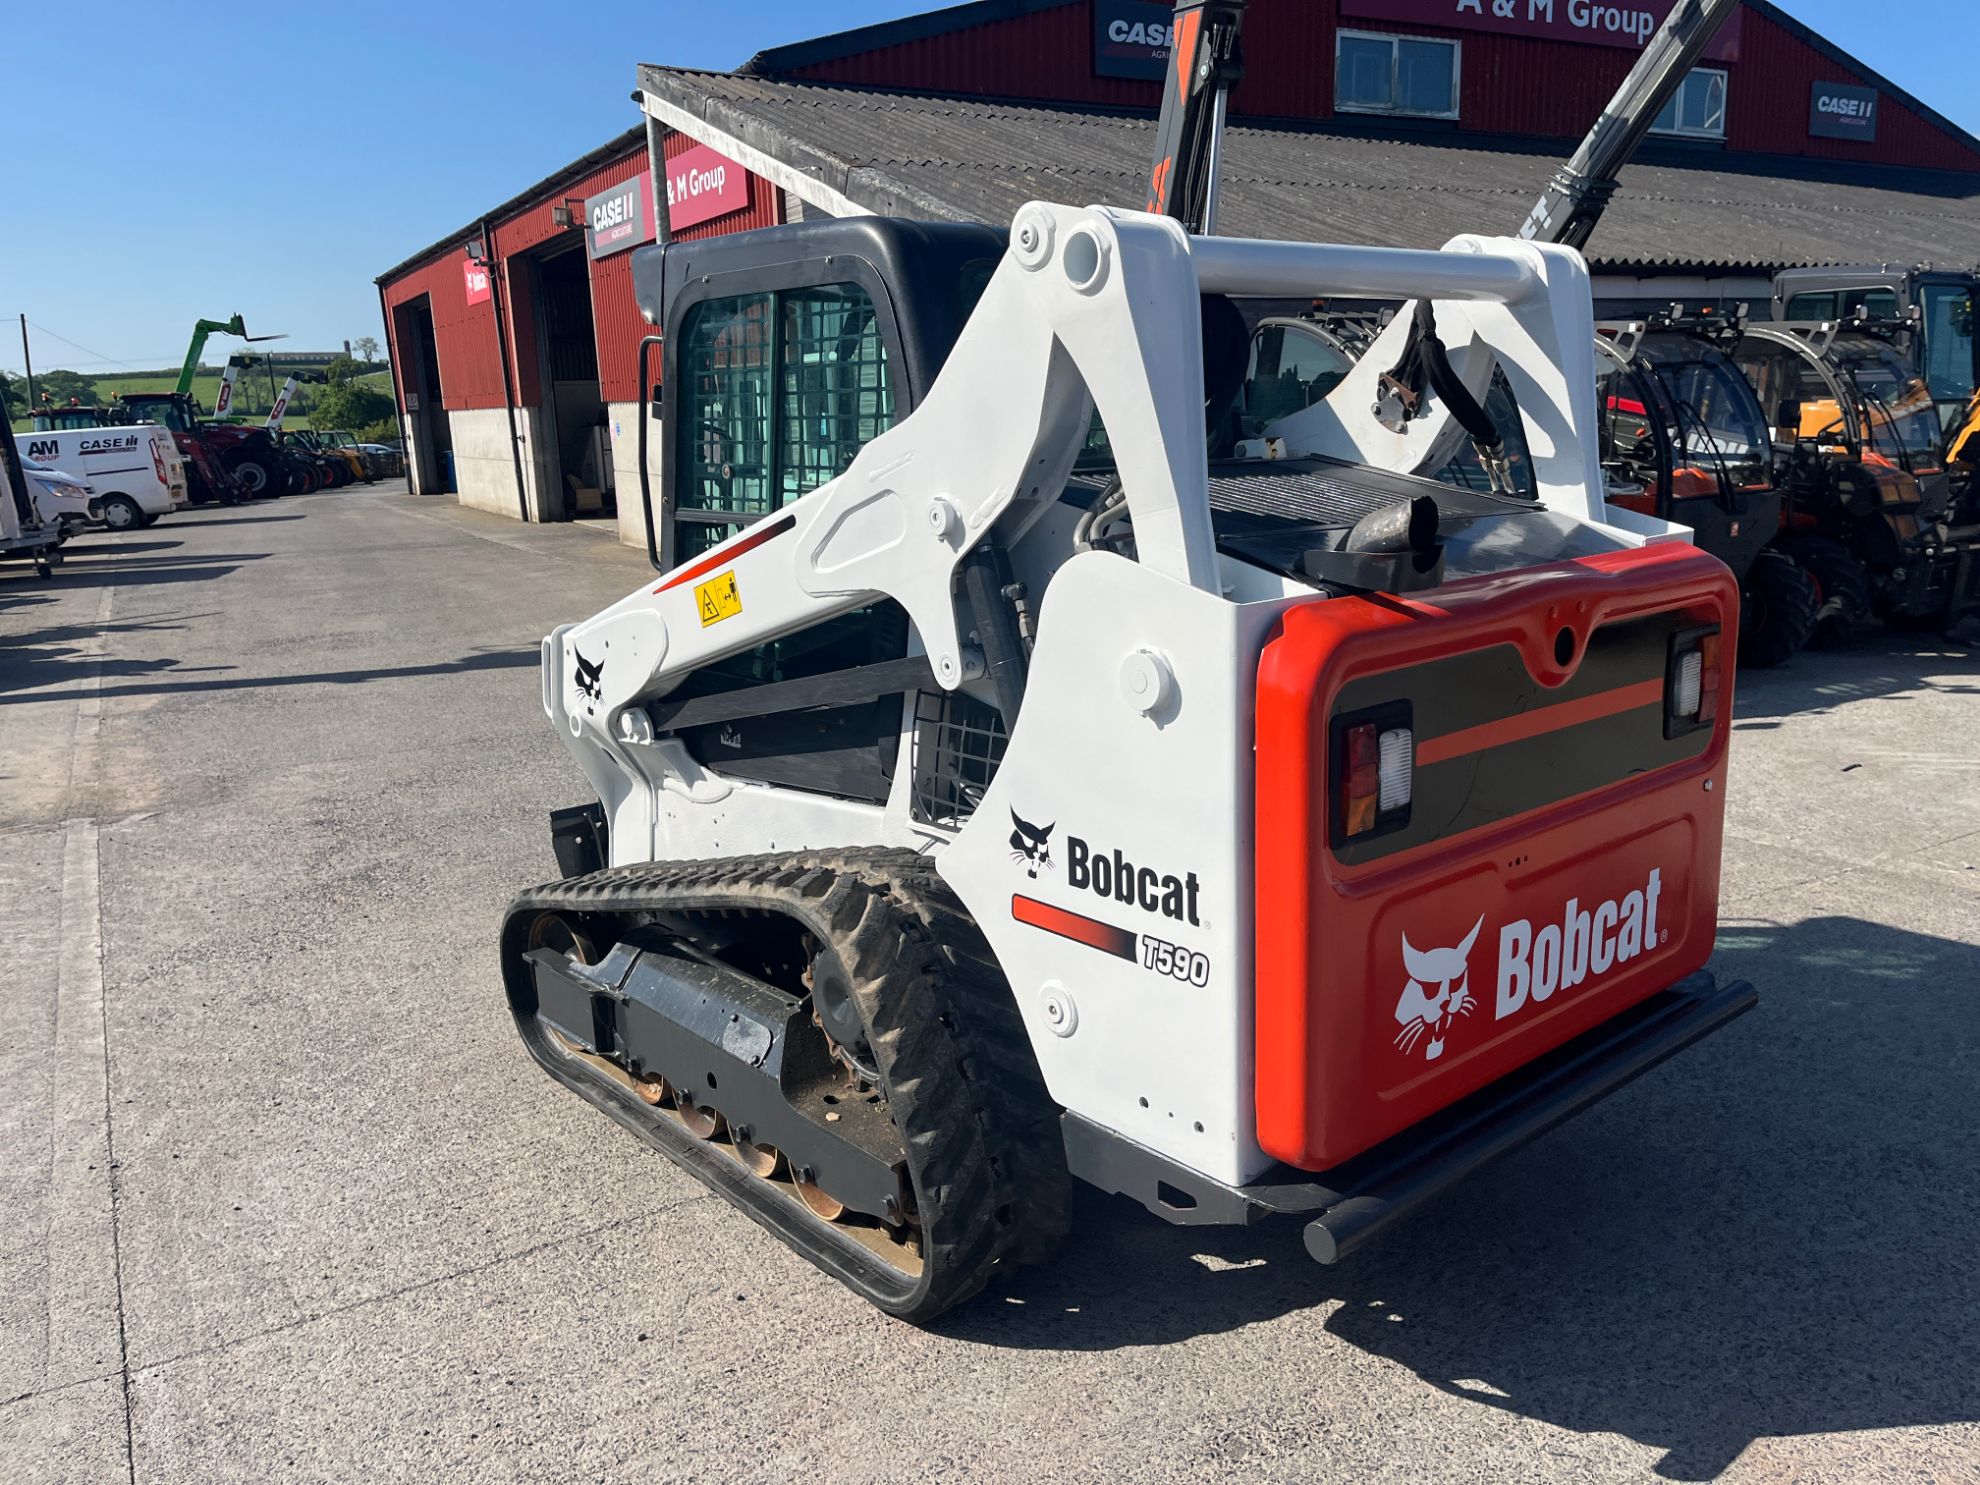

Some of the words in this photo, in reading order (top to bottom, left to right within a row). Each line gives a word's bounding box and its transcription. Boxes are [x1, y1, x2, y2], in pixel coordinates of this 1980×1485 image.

[1528, 0, 1553, 23] M
[1567, 0, 1654, 45] Group
[676, 174, 688, 203] M
[689, 165, 725, 195] Group
[28, 440, 60, 456] AM
[80, 438, 123, 450] CASE
[1067, 835, 1200, 927] Bobcat
[1142, 935, 1210, 988] T590
[1495, 866, 1662, 1020] Bobcat
